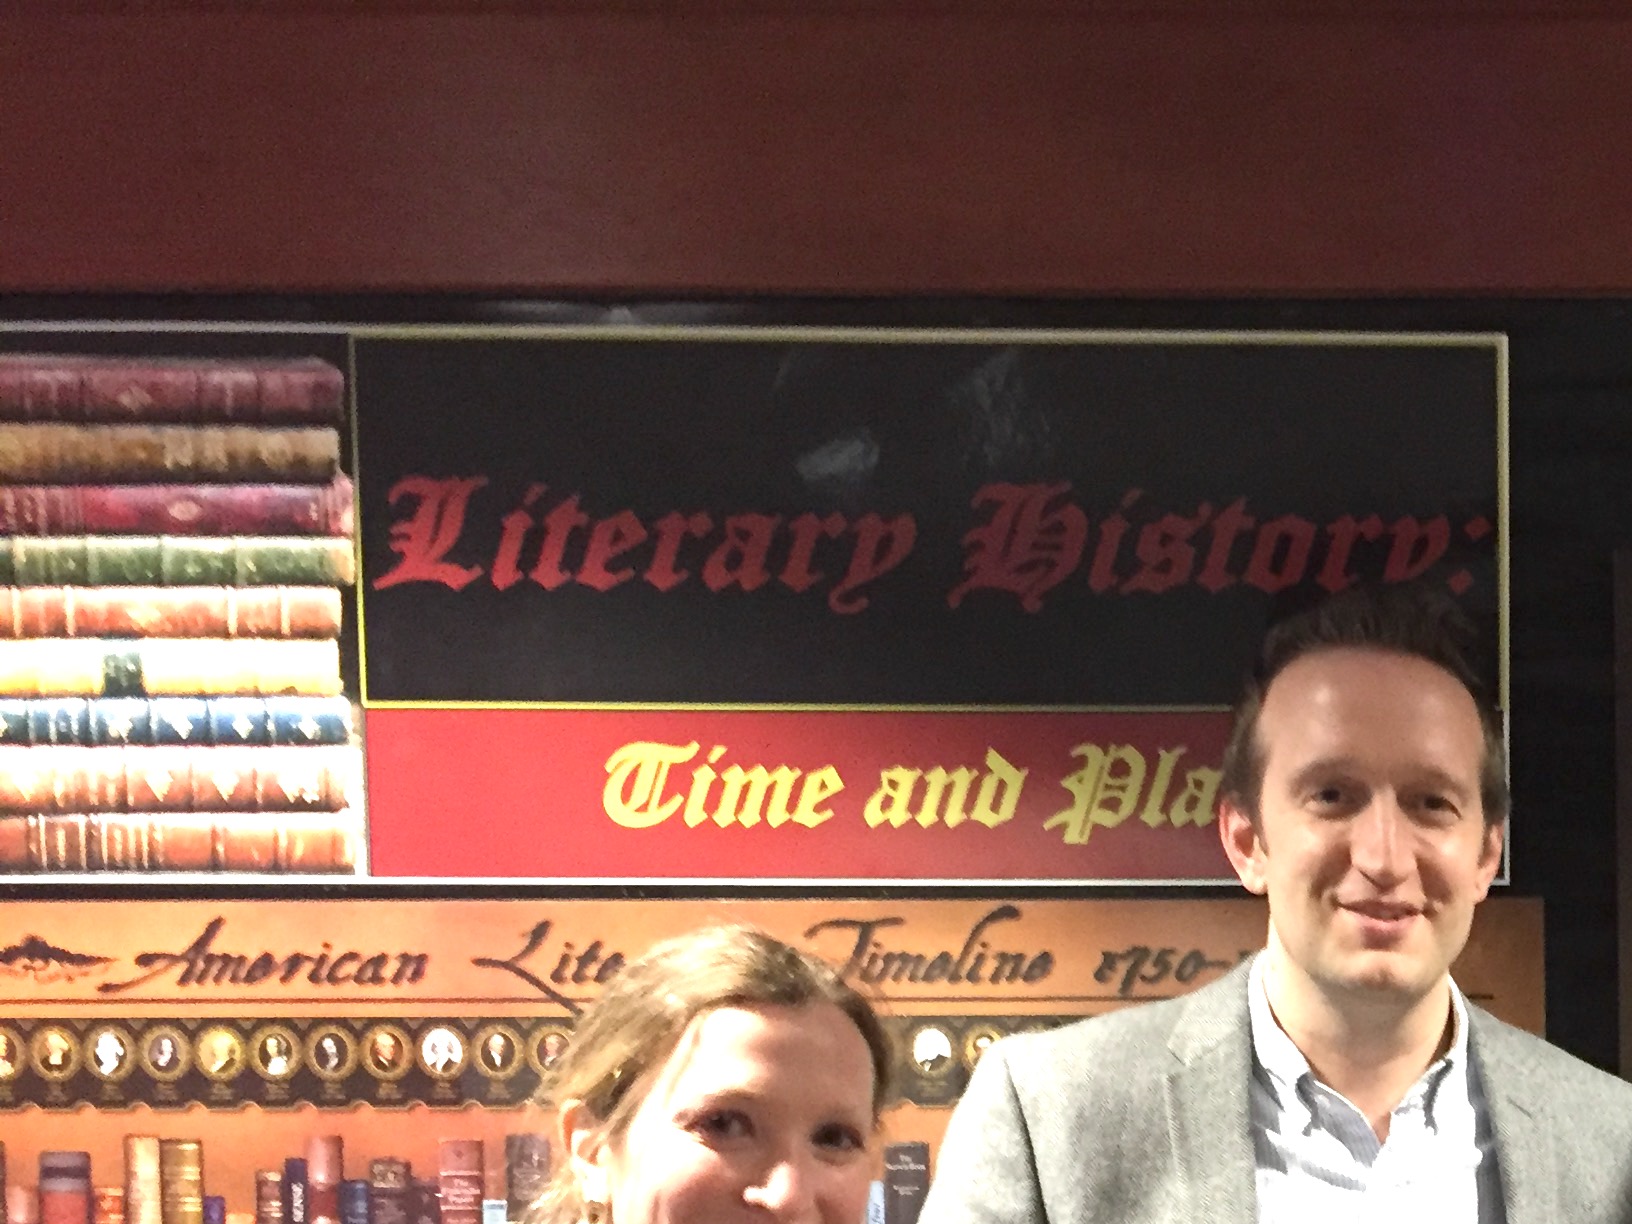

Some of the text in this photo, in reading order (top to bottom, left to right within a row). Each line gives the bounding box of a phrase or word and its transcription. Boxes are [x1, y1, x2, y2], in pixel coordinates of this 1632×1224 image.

[372, 475, 1493, 614] Literary History:
[602, 739, 846, 830] Time
[862, 746, 1030, 830] and
[96, 914, 430, 994] American
[803, 904, 1056, 986] Timeline
